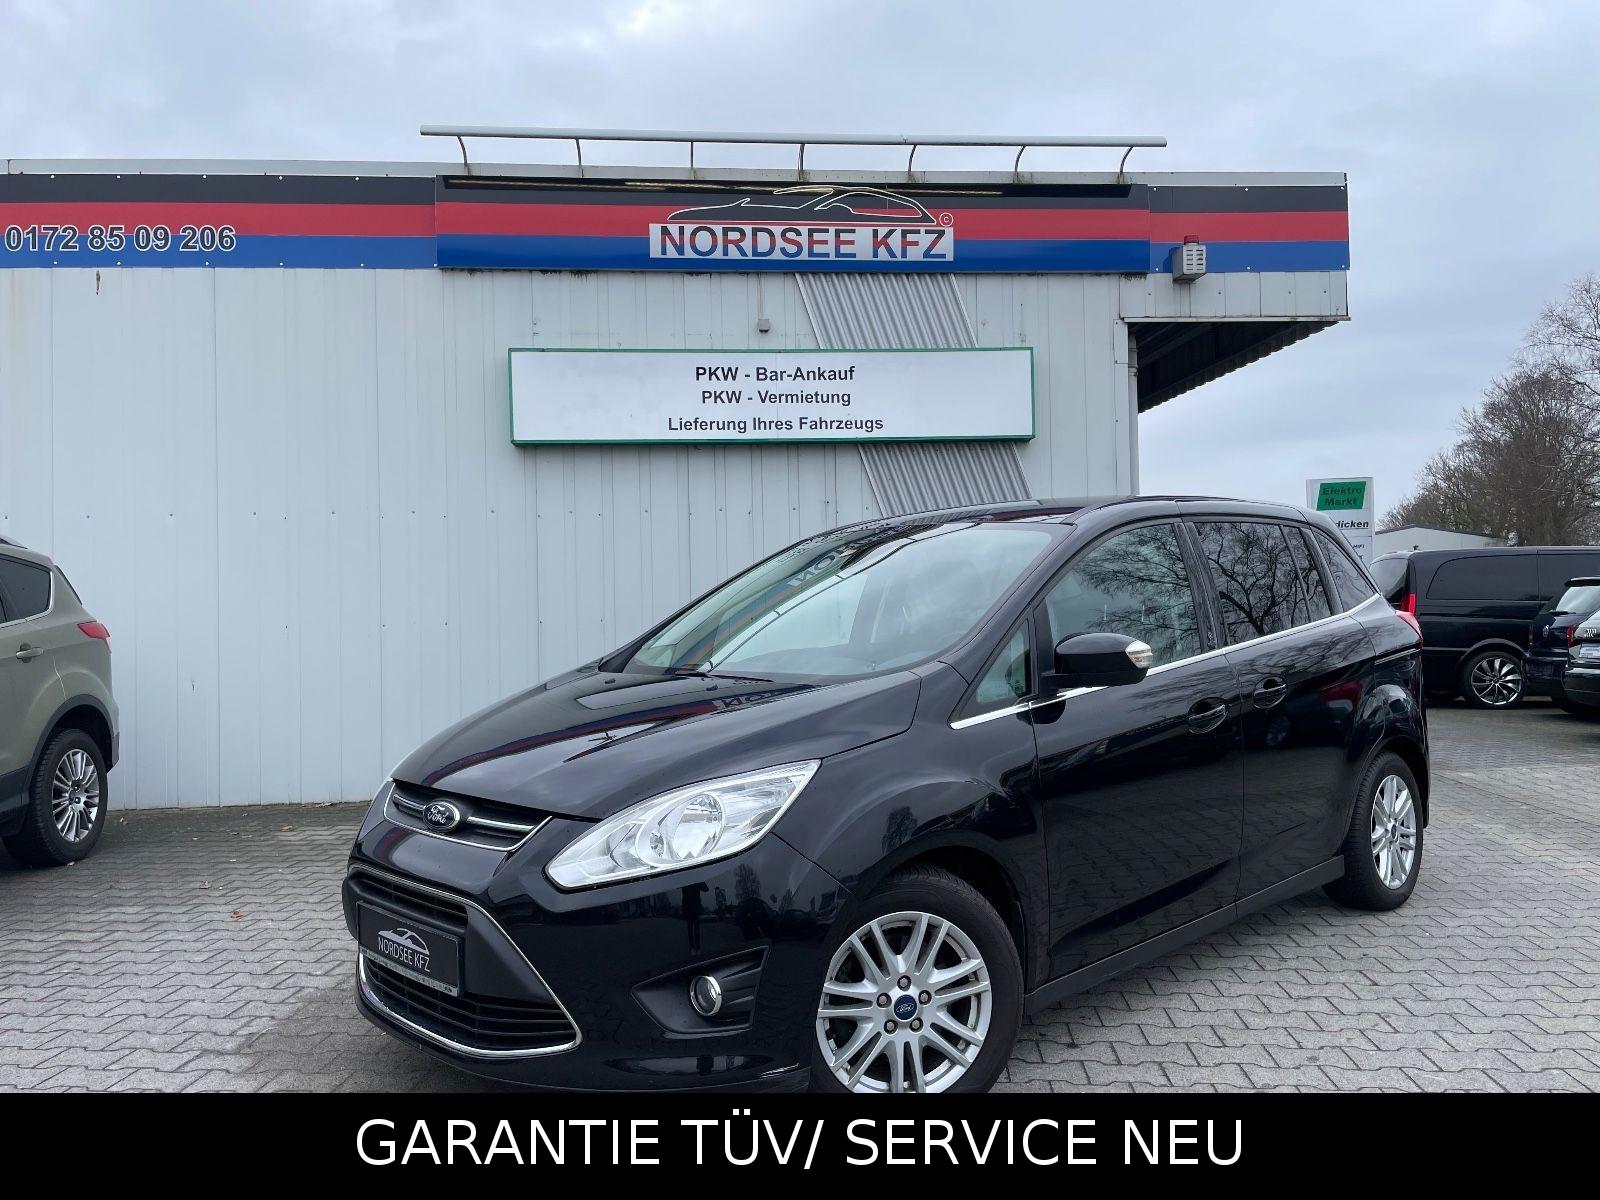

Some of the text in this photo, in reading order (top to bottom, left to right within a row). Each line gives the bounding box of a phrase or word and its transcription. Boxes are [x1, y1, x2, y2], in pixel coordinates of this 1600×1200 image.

[4, 224, 237, 252] 0172 85 09 206
[659, 225, 948, 259] NORDSEE KFZ
[695, 366, 739, 382] PKW
[756, 365, 856, 382] Bar-Ankauf
[701, 390, 742, 404] PKW
[757, 389, 851, 407] Vermietung
[668, 416, 884, 434] Lieferung Ihres Fahrzeugs
[1322, 486, 1362, 496] Elektro
[1324, 497, 1356, 507] Markt
[377, 935, 413, 965] NORDSEE
[414, 952, 431, 973] KFZ
